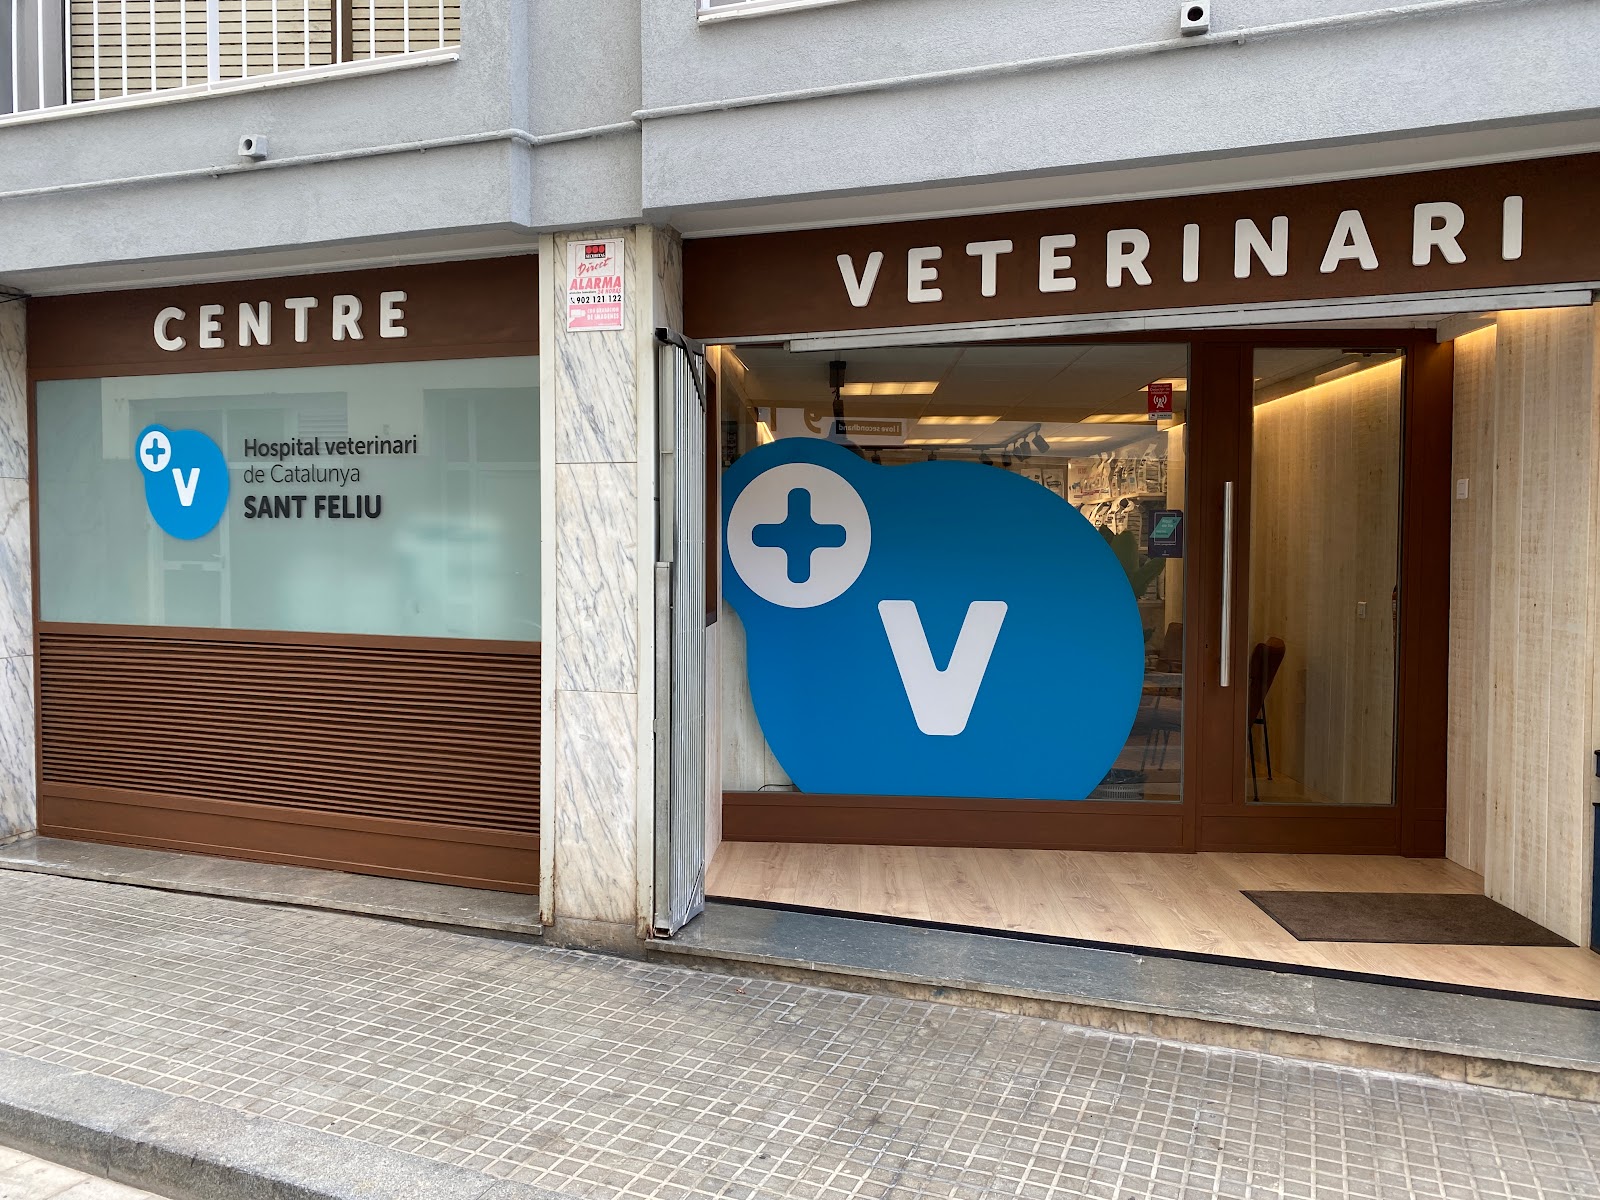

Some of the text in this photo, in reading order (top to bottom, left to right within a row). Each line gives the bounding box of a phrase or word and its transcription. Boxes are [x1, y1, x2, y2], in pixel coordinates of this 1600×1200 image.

[836, 194, 1524, 309] VETERINARI
[578, 257, 612, 276] Direct
[570, 276, 621, 290] ALARMA
[576, 294, 622, 304] 902 121 122
[153, 290, 408, 352] CENTRE
[244, 434, 418, 461] Hospital veterinari
[243, 463, 361, 488] de Catalunya
[243, 494, 382, 519] SANT FELIU
